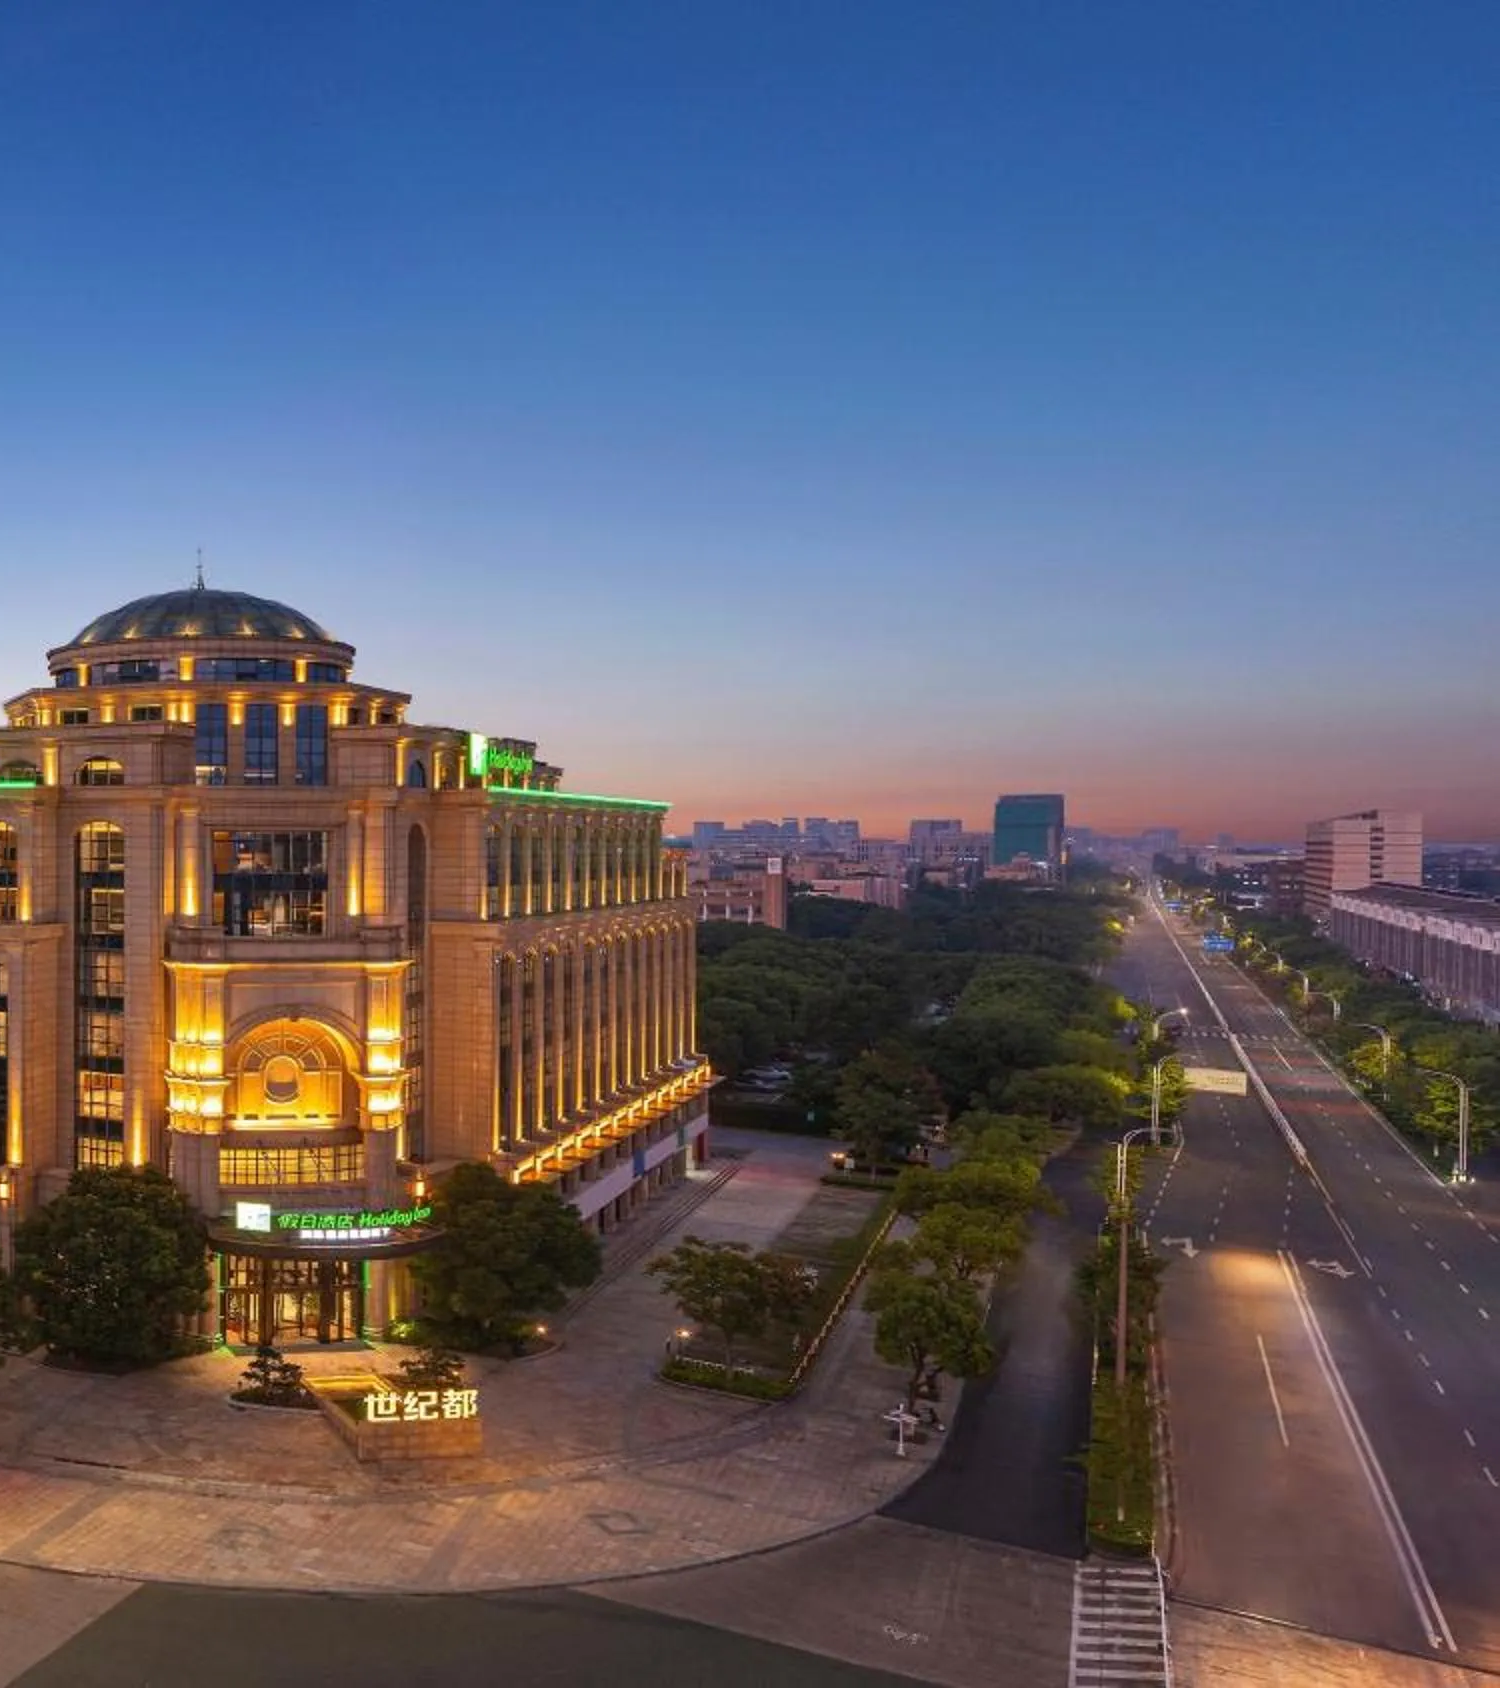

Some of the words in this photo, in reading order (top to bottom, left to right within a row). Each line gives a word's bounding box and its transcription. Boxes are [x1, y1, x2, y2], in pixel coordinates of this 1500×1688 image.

[277, 1213, 354, 1229] 假日酒店
[359, 1208, 413, 1228] Holiday
[364, 1389, 478, 1422] 世纪都
